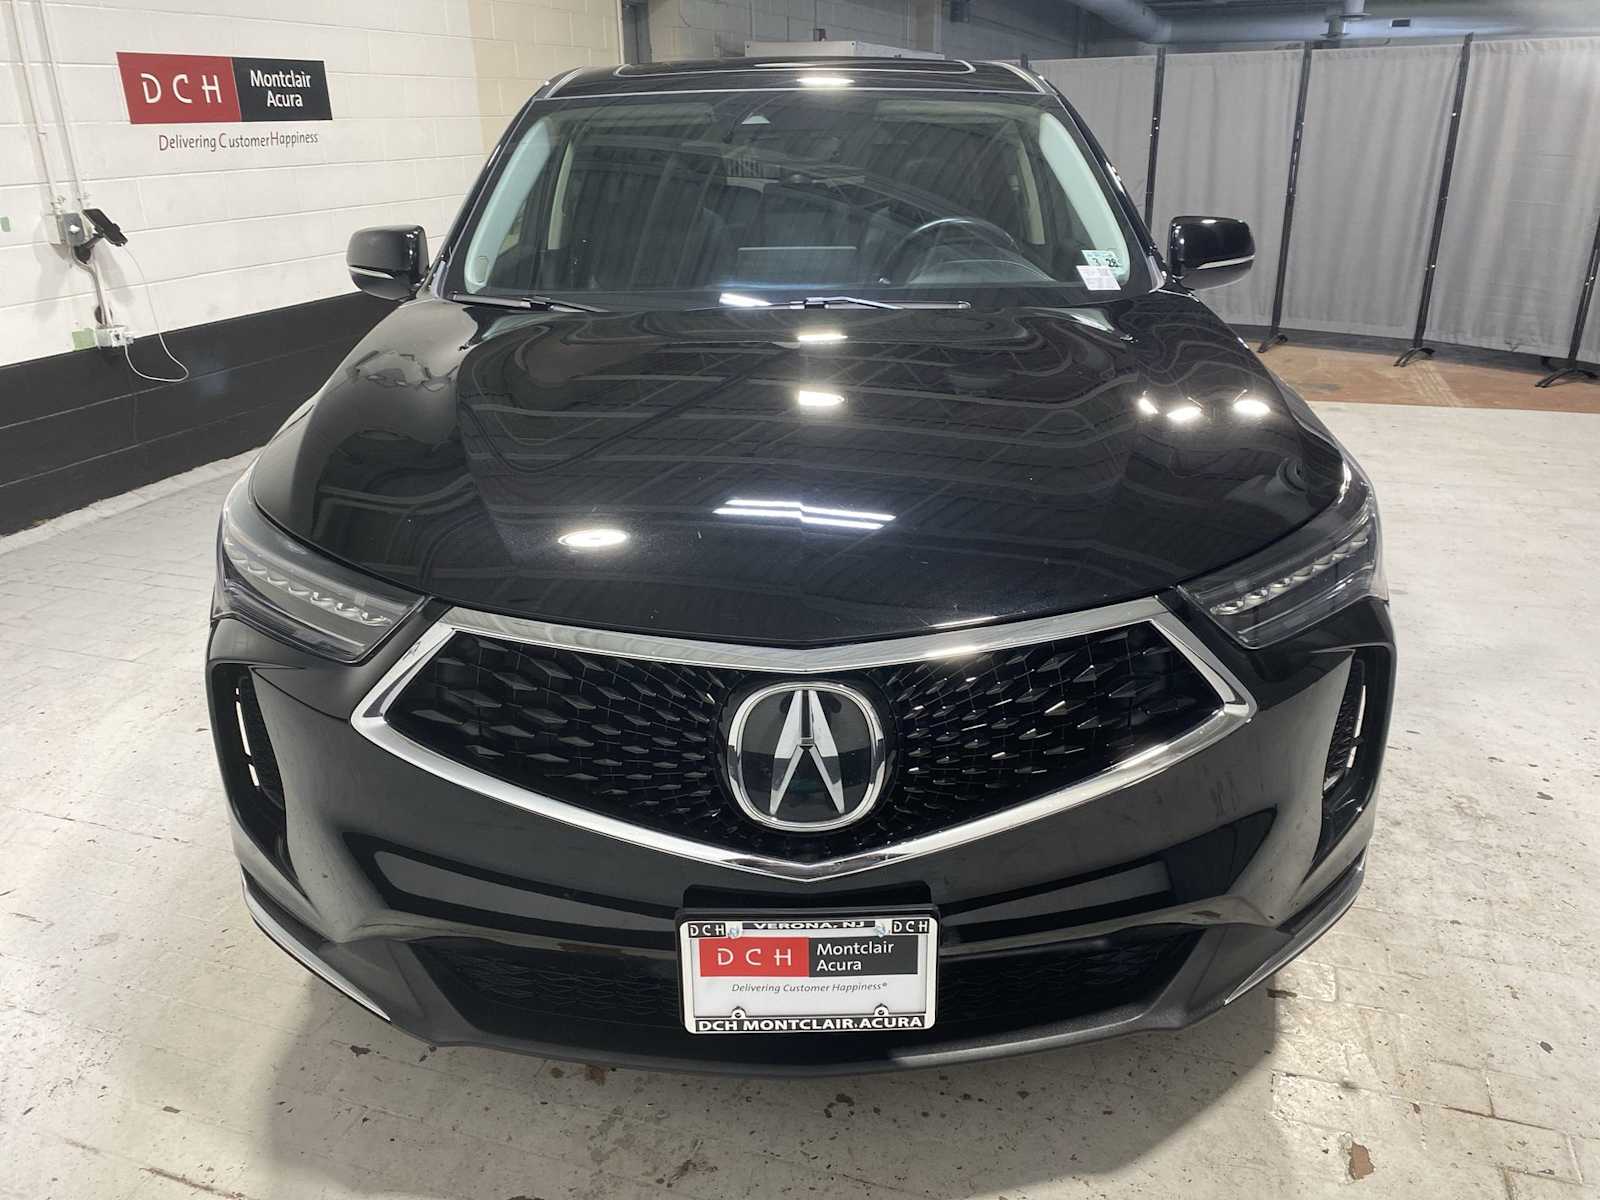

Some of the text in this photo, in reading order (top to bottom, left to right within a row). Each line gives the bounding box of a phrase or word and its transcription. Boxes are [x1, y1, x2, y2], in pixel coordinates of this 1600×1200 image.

[250, 70, 311, 89] Montclair
[141, 73, 222, 104] DCH
[267, 90, 303, 108] Acura
[159, 131, 318, 152] Delivering Customer Happiness
[689, 925, 725, 936] DCH
[753, 922, 839, 930] VERONA,
[893, 920, 929, 932] DCH
[816, 940, 895, 956] Montclair
[717, 948, 792, 966] DCH
[816, 959, 862, 972] Acura
[731, 983, 781, 994] Delivering
[783, 983, 830, 992] Customer
[699, 1020, 738, 1031] DCH
[859, 1016, 923, 1029] ACURA
